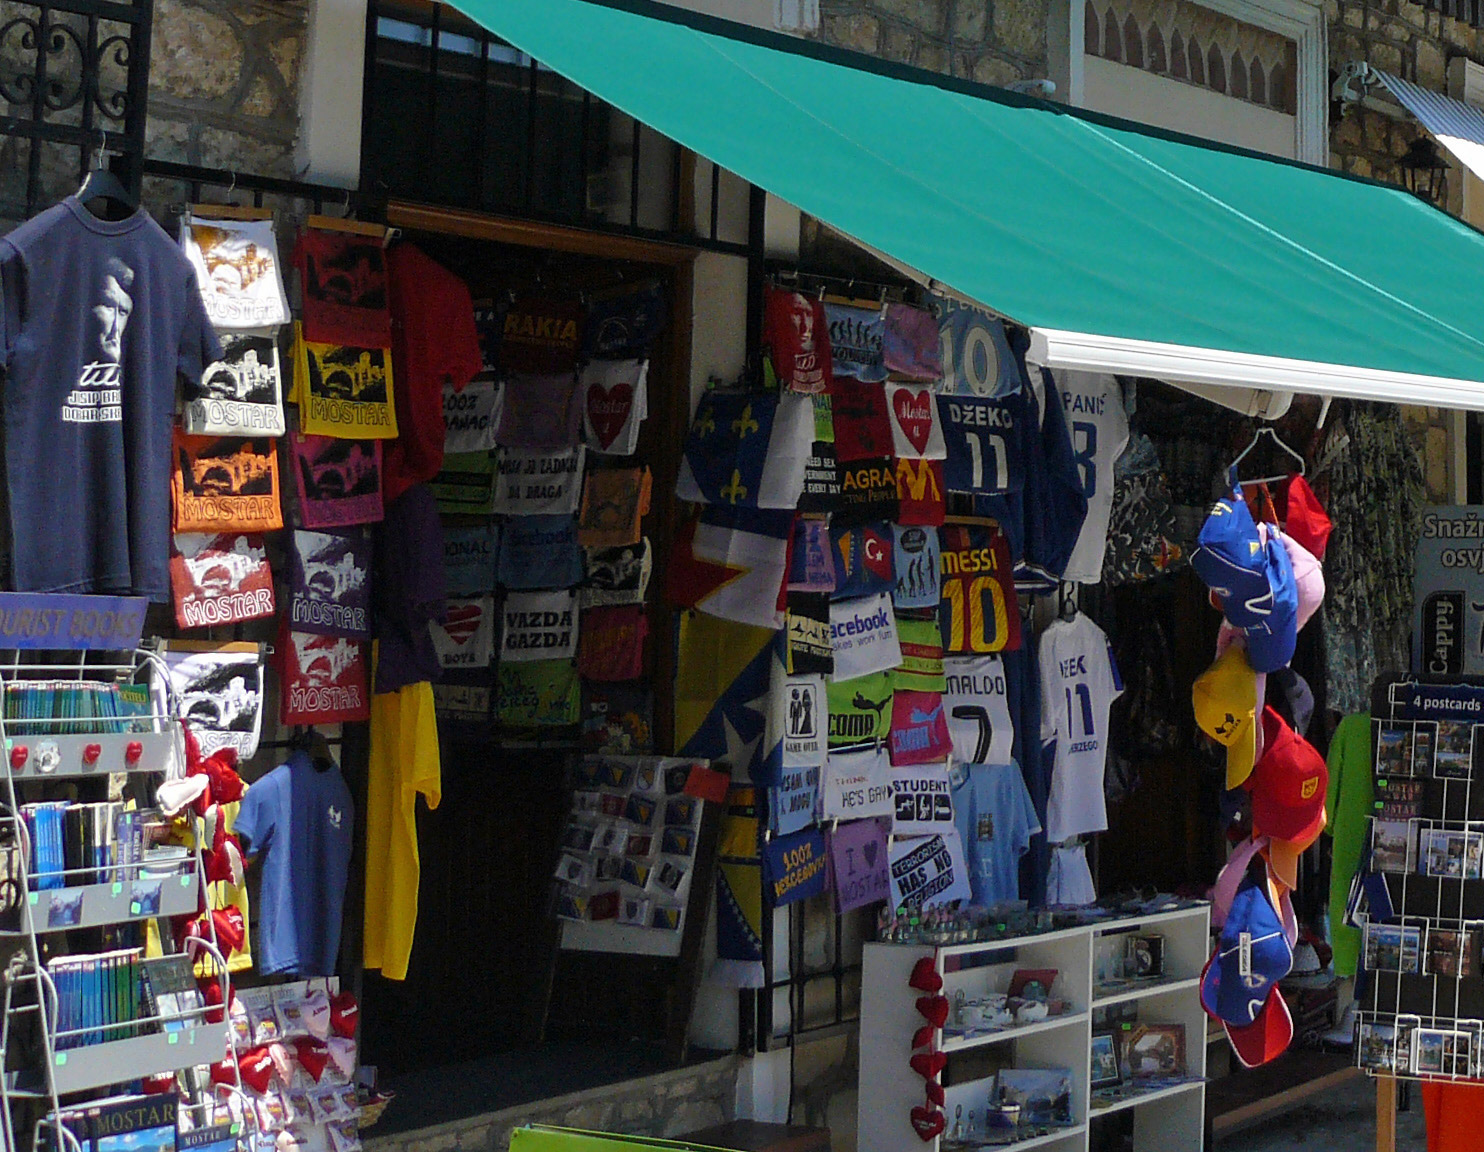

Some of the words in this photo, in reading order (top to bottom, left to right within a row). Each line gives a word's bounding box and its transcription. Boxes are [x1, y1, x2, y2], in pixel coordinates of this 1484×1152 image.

[939, 318, 999, 397] 10
[311, 398, 390, 425] MOSTAR
[949, 404, 1013, 429] DŽEKO
[965, 432, 1009, 489] 11
[184, 497, 274, 521] MOSTAR
[940, 548, 998, 575] MESSI
[184, 589, 274, 627] MOSTAR
[293, 598, 367, 631] MOSTAR
[506, 611, 573, 629] VAZDA
[830, 607, 889, 639] acebook
[942, 576, 1008, 652] 10
[70, 609, 138, 638] BOOKS
[1429, 597, 1455, 676] Cappy
[506, 631, 571, 650] GAZDA
[289, 686, 361, 713] MOSTAR
[1413, 695, 1421, 707] 4
[1424, 699, 1481, 710] postcards
[951, 705, 993, 764] 7
[893, 779, 948, 793] STUDENT
[783, 842, 812, 872] 100%
[898, 867, 928, 897] HAS
[98, 1102, 175, 1134] MOSTAR
